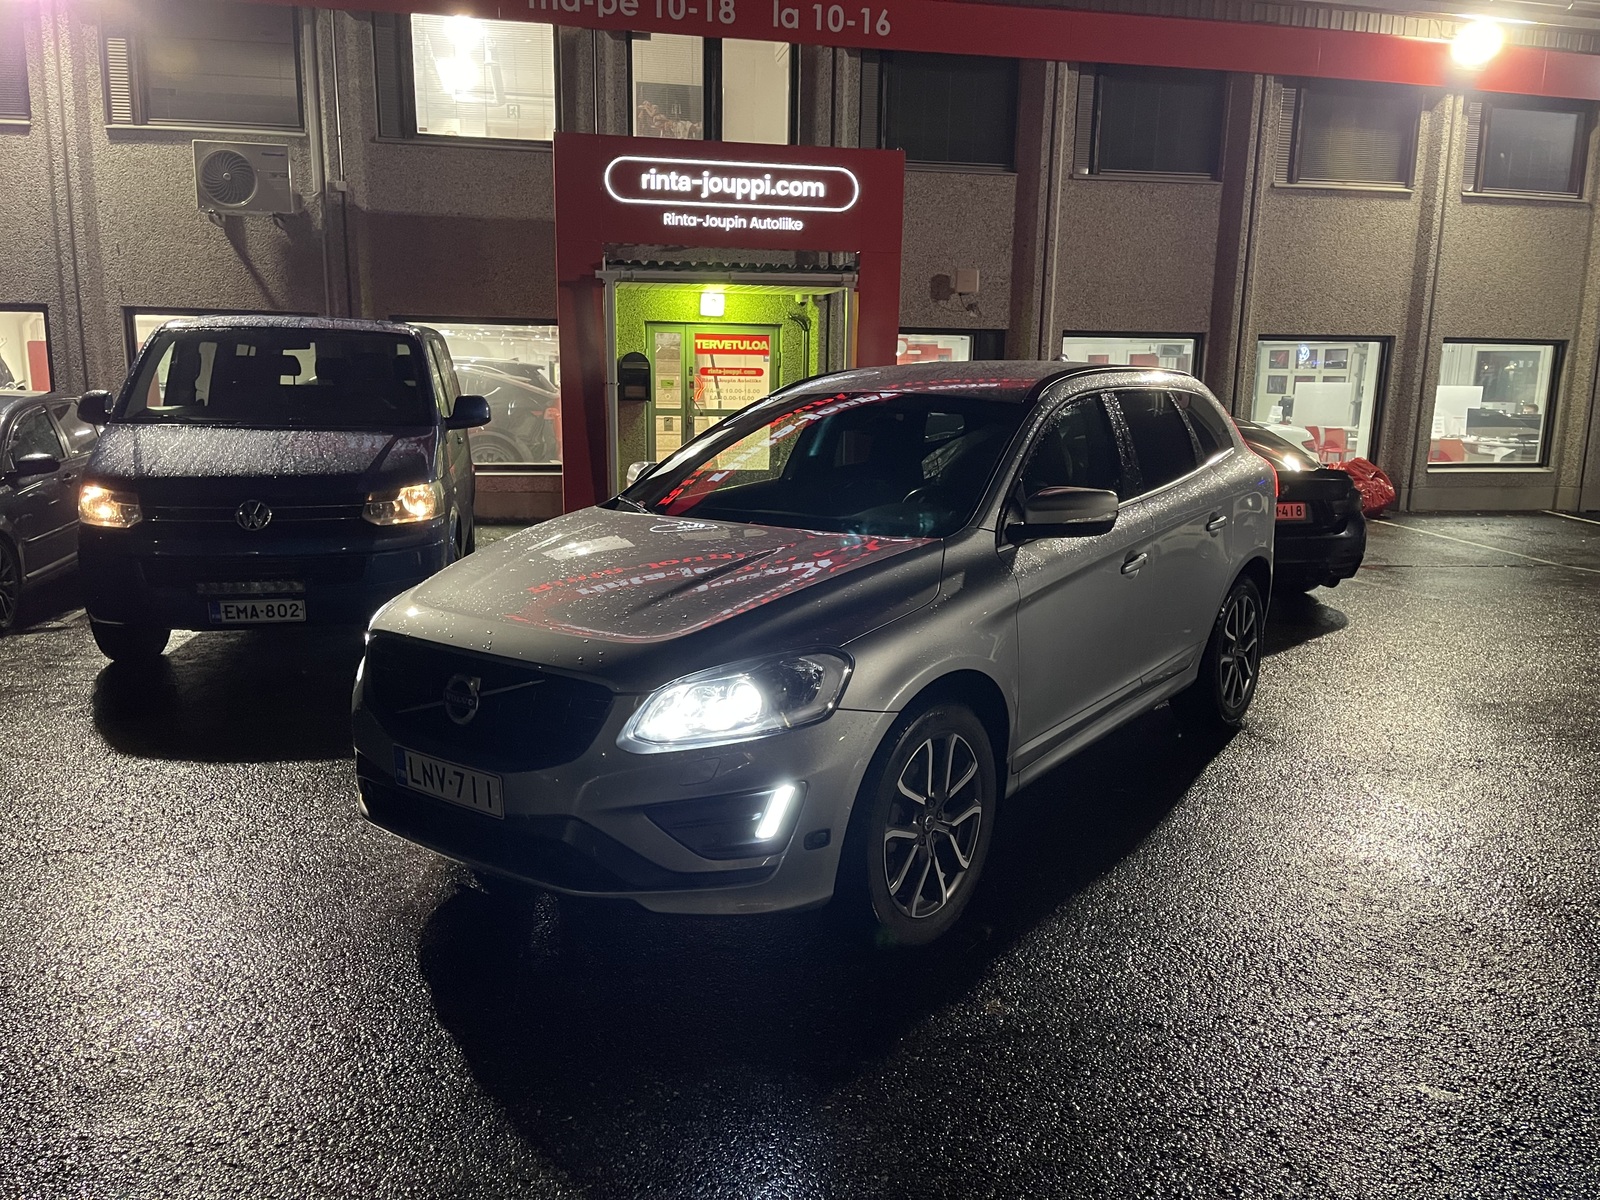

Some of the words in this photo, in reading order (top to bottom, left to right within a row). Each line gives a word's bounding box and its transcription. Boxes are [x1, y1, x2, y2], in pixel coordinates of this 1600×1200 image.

[655, 0, 736, 24] 10-18
[773, 0, 799, 29] la
[812, 4, 891, 36] 10-16
[641, 168, 825, 200] rinta-jouppi.com
[663, 213, 747, 231] Rinta-Joupin
[750, 217, 803, 231] Autoliike
[695, 339, 769, 350] TERVETULOA
[224, 603, 300, 619] EMA-802
[409, 756, 492, 808] LNV-711
